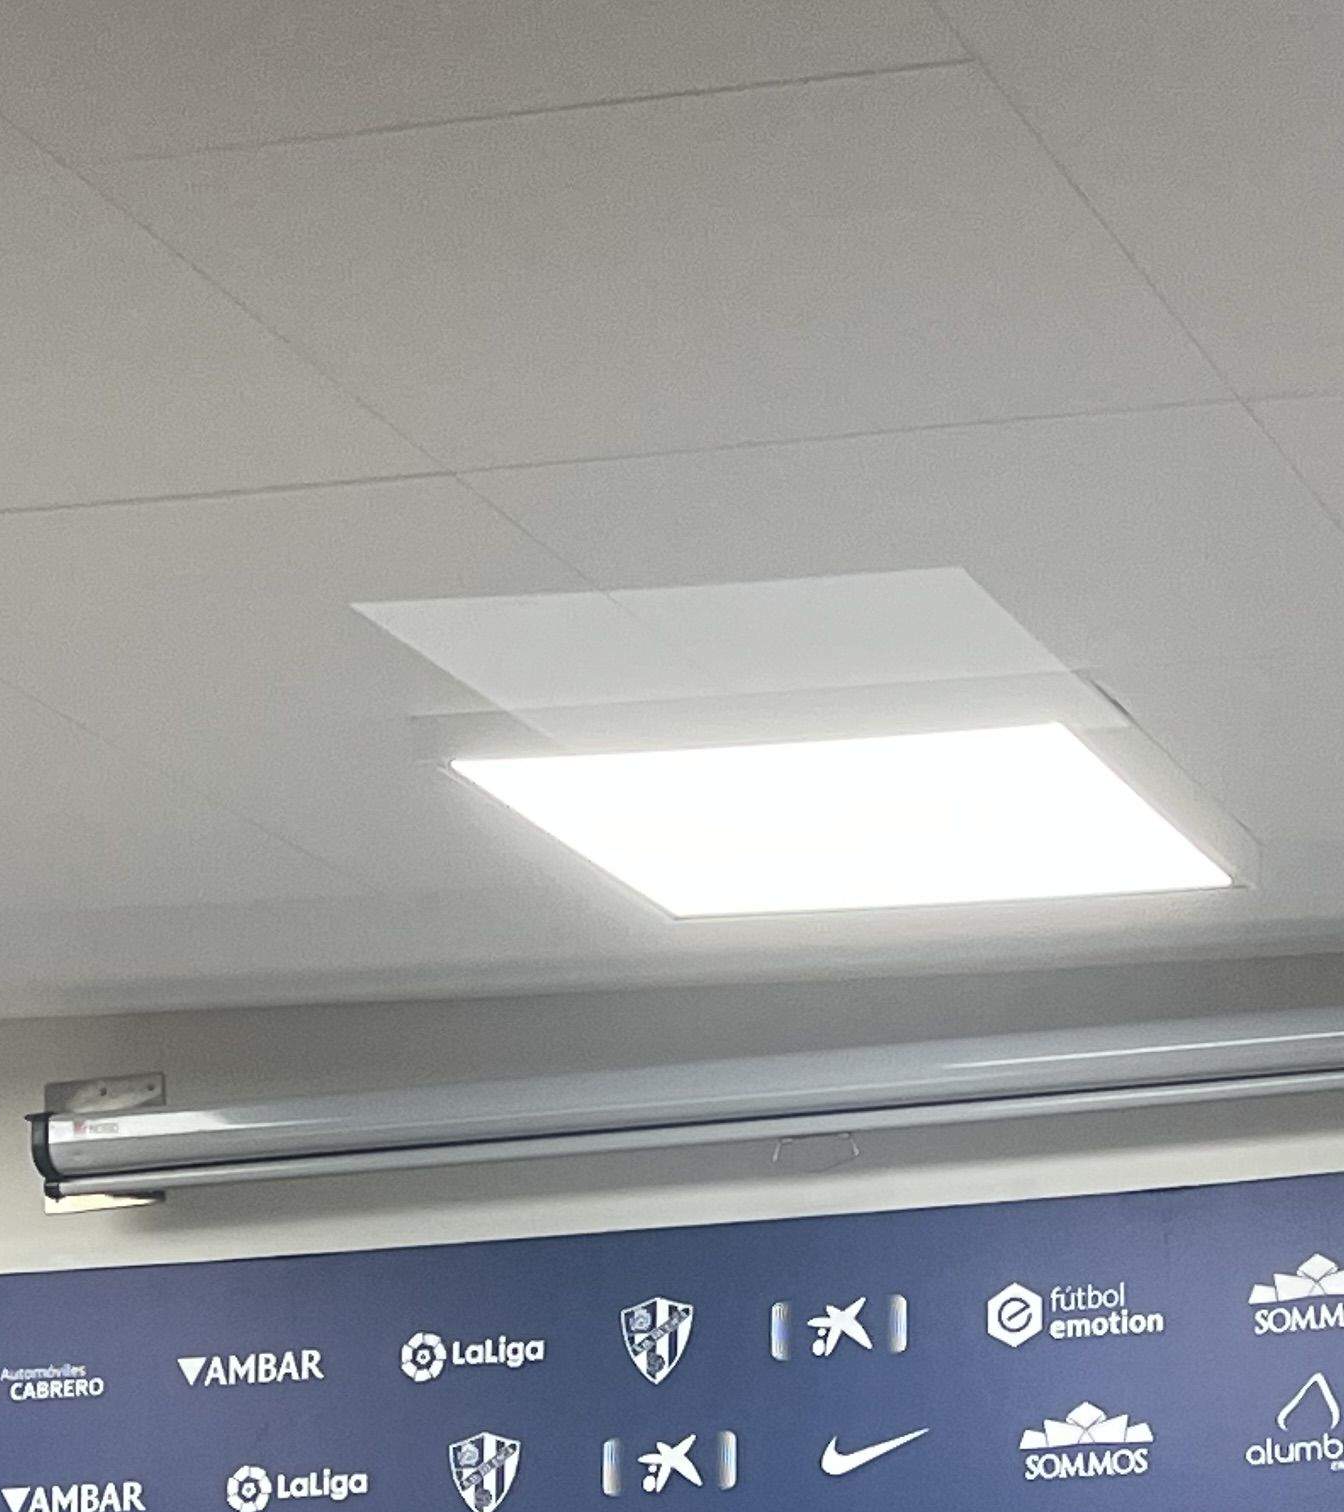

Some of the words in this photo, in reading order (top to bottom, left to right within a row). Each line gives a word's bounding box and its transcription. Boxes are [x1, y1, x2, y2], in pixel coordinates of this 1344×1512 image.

[1051, 1282, 1124, 1312] fútbol
[1049, 1309, 1163, 1339] emotion
[453, 1335, 544, 1367] LaLiga
[205, 1350, 324, 1386] AMBAR
[10, 1378, 104, 1400] CABRERO
[1025, 1449, 1148, 1479] SOMMOS
[278, 1468, 368, 1500] LaLiga
